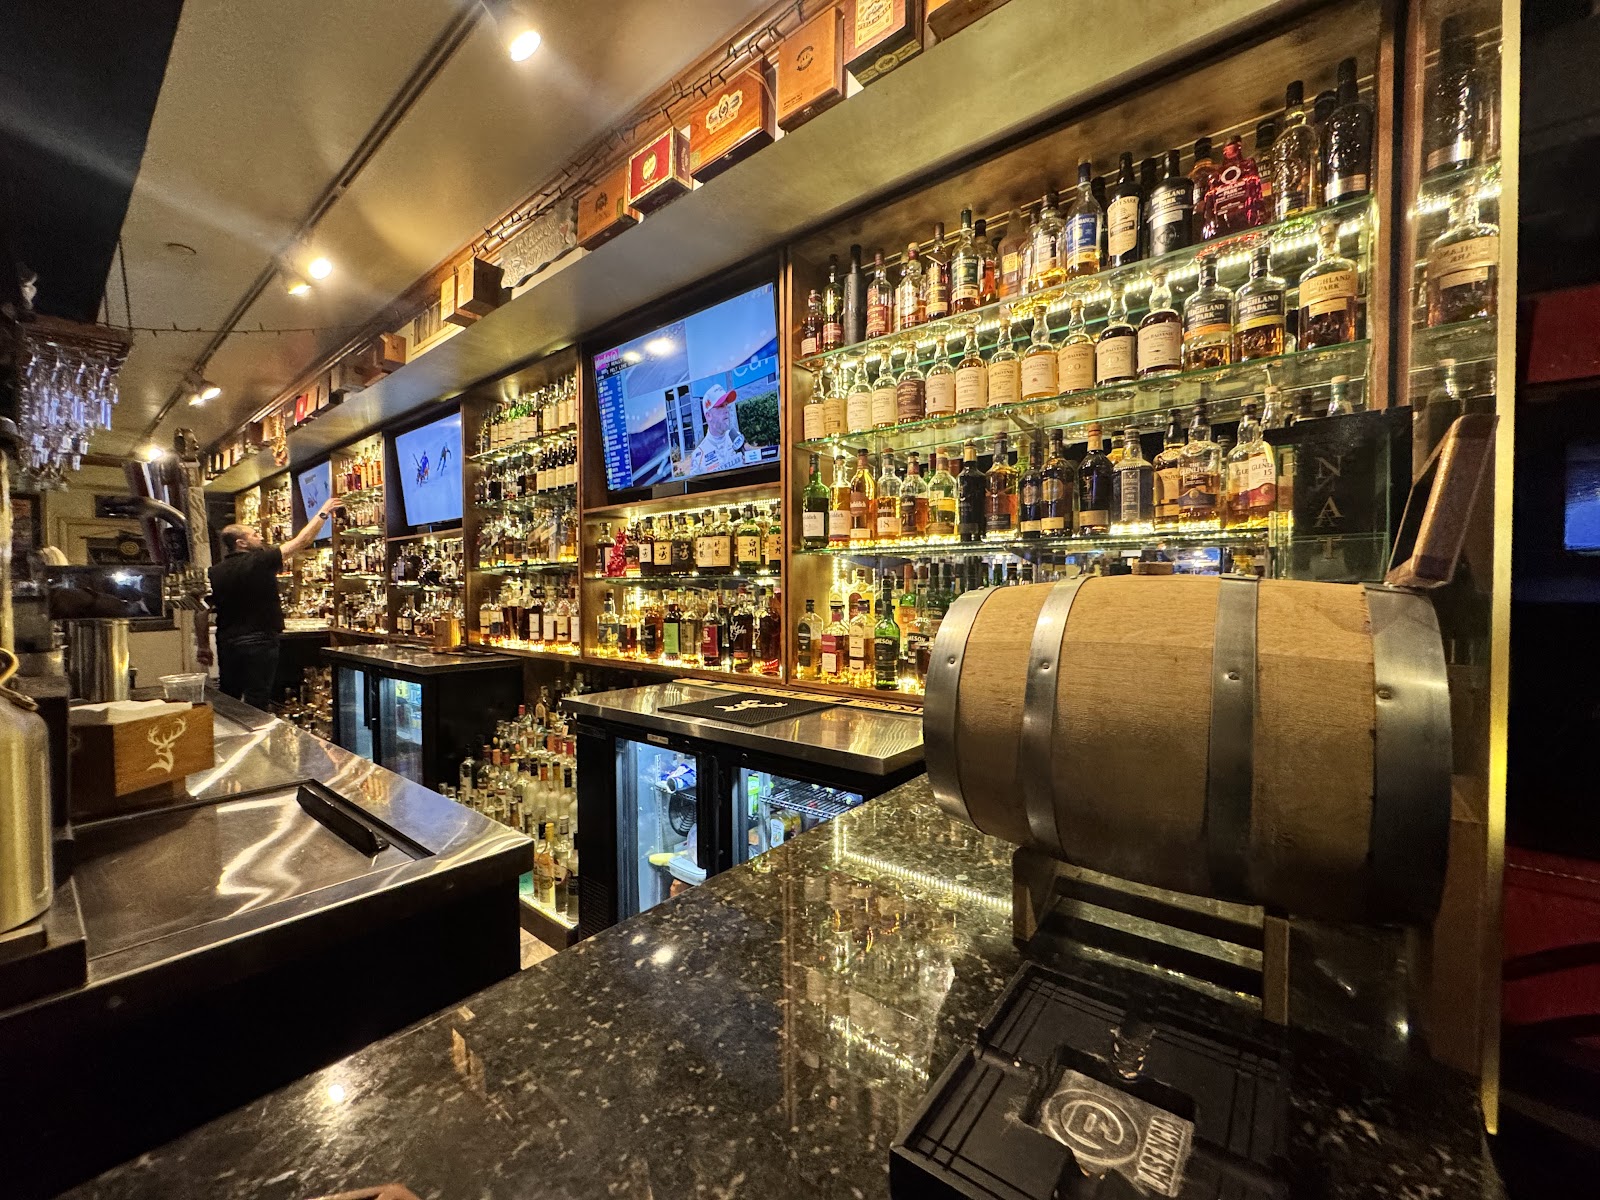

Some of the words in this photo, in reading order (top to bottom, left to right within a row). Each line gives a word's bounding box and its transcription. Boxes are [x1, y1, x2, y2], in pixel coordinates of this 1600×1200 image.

[1238, 294, 1279, 311] HIGHLAND
[1247, 303, 1268, 314] PARK
[1187, 302, 1225, 318] HIGHLAND
[1195, 311, 1215, 322] PARK
